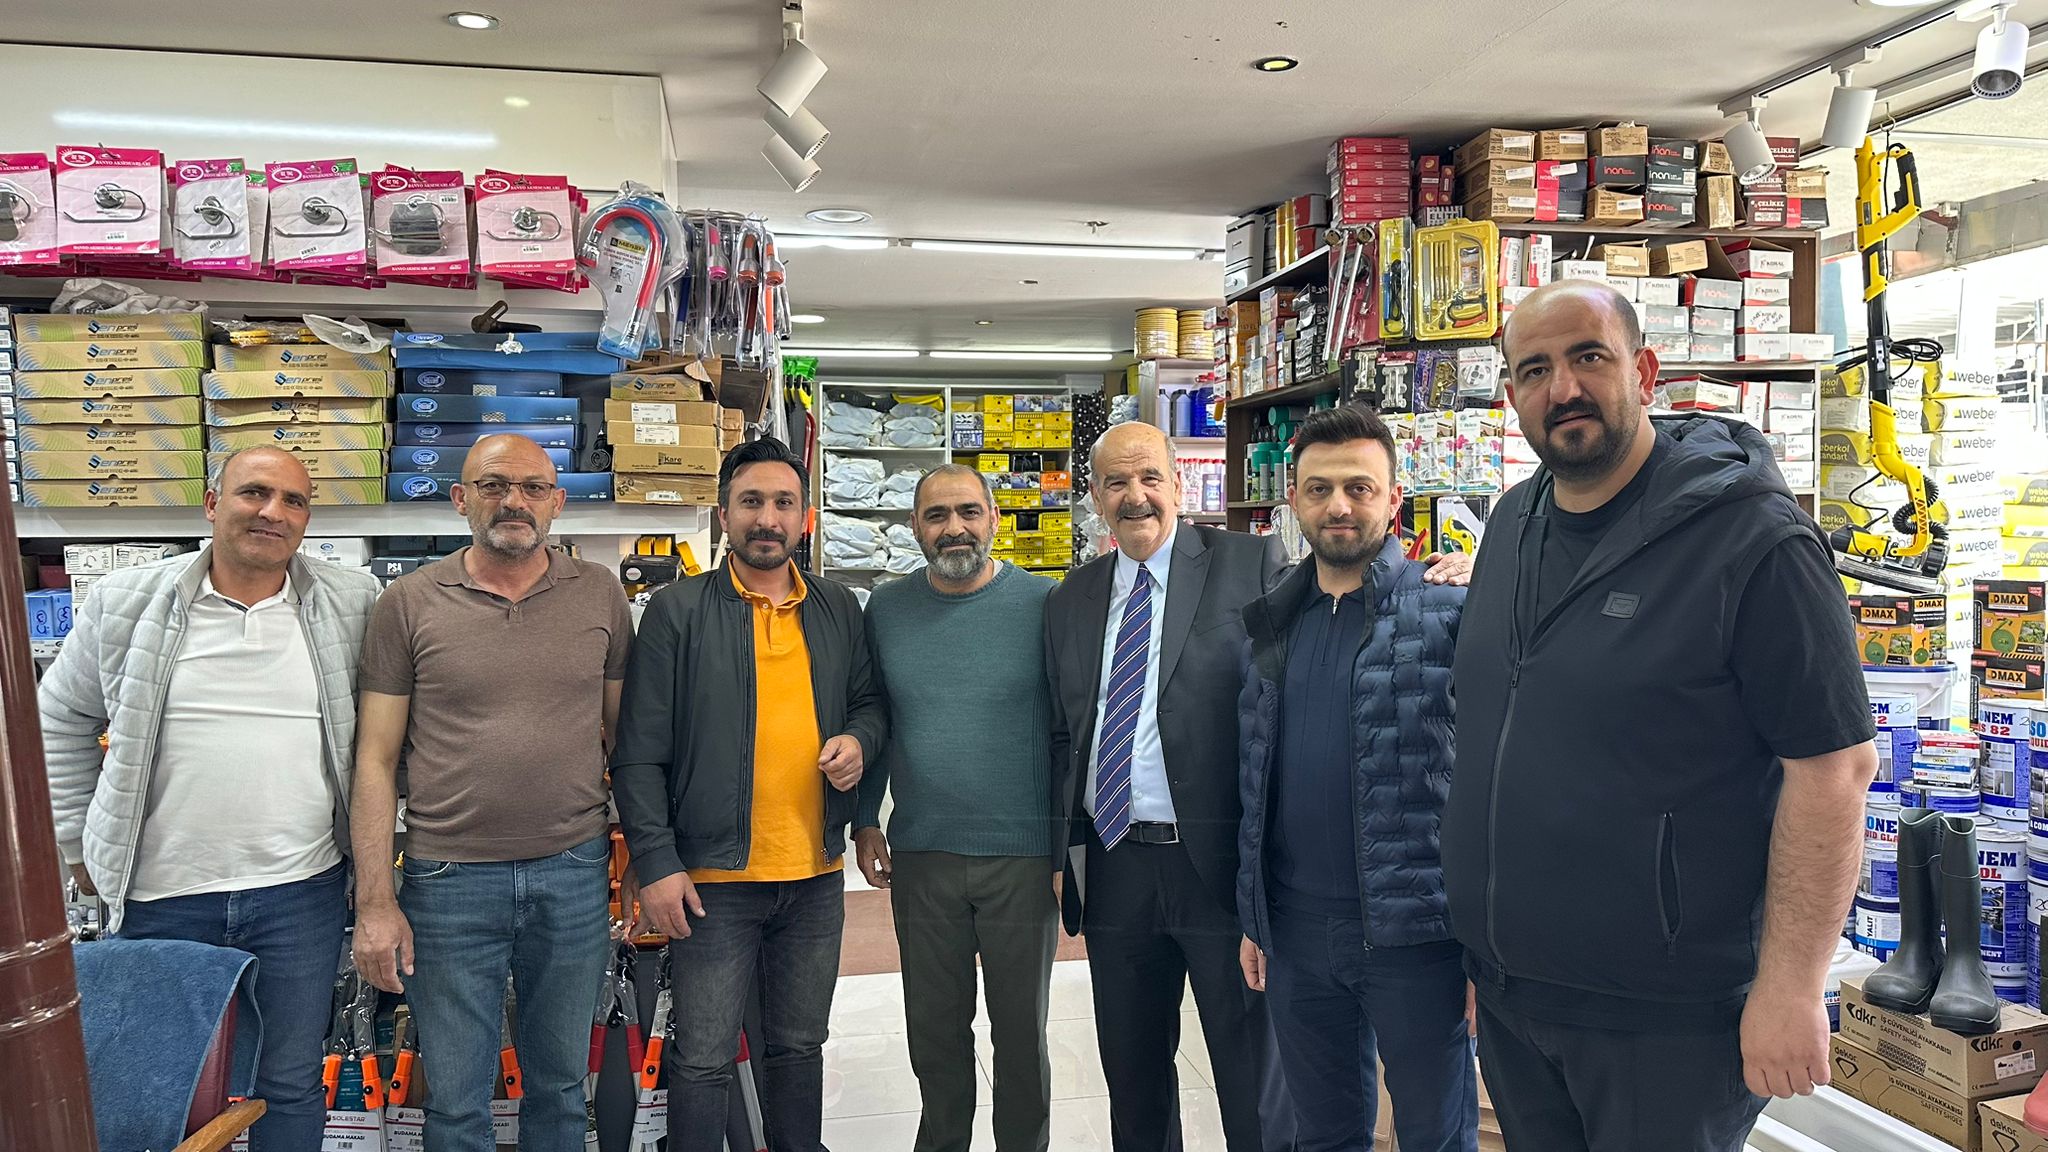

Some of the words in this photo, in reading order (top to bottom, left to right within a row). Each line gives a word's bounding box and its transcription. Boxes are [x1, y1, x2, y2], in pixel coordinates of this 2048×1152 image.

[1604, 166, 1624, 175] inan
[1649, 170, 1671, 180] inan
[1894, 376, 1920, 389] eber
[1956, 371, 1995, 385] weber
[1895, 408, 1919, 420] eber
[1961, 407, 1998, 420] weber
[1961, 437, 1996, 449] weber
[1821, 451, 1848, 461] andart
[1901, 443, 1928, 457] eber
[1957, 470, 1995, 484] weber
[1820, 514, 1847, 524] berkol
[1964, 507, 2002, 519] weber
[387, 562, 403, 573] PSA
[1990, 725, 2010, 736] 82
[1866, 816, 1898, 834] ONE
[1879, 1025, 1901, 1040] SAFETY
[1902, 1035, 1922, 1050] SHOES
[1920, 1100, 1943, 1116] SAFETY
[1943, 1110, 1963, 1127] SHOES
